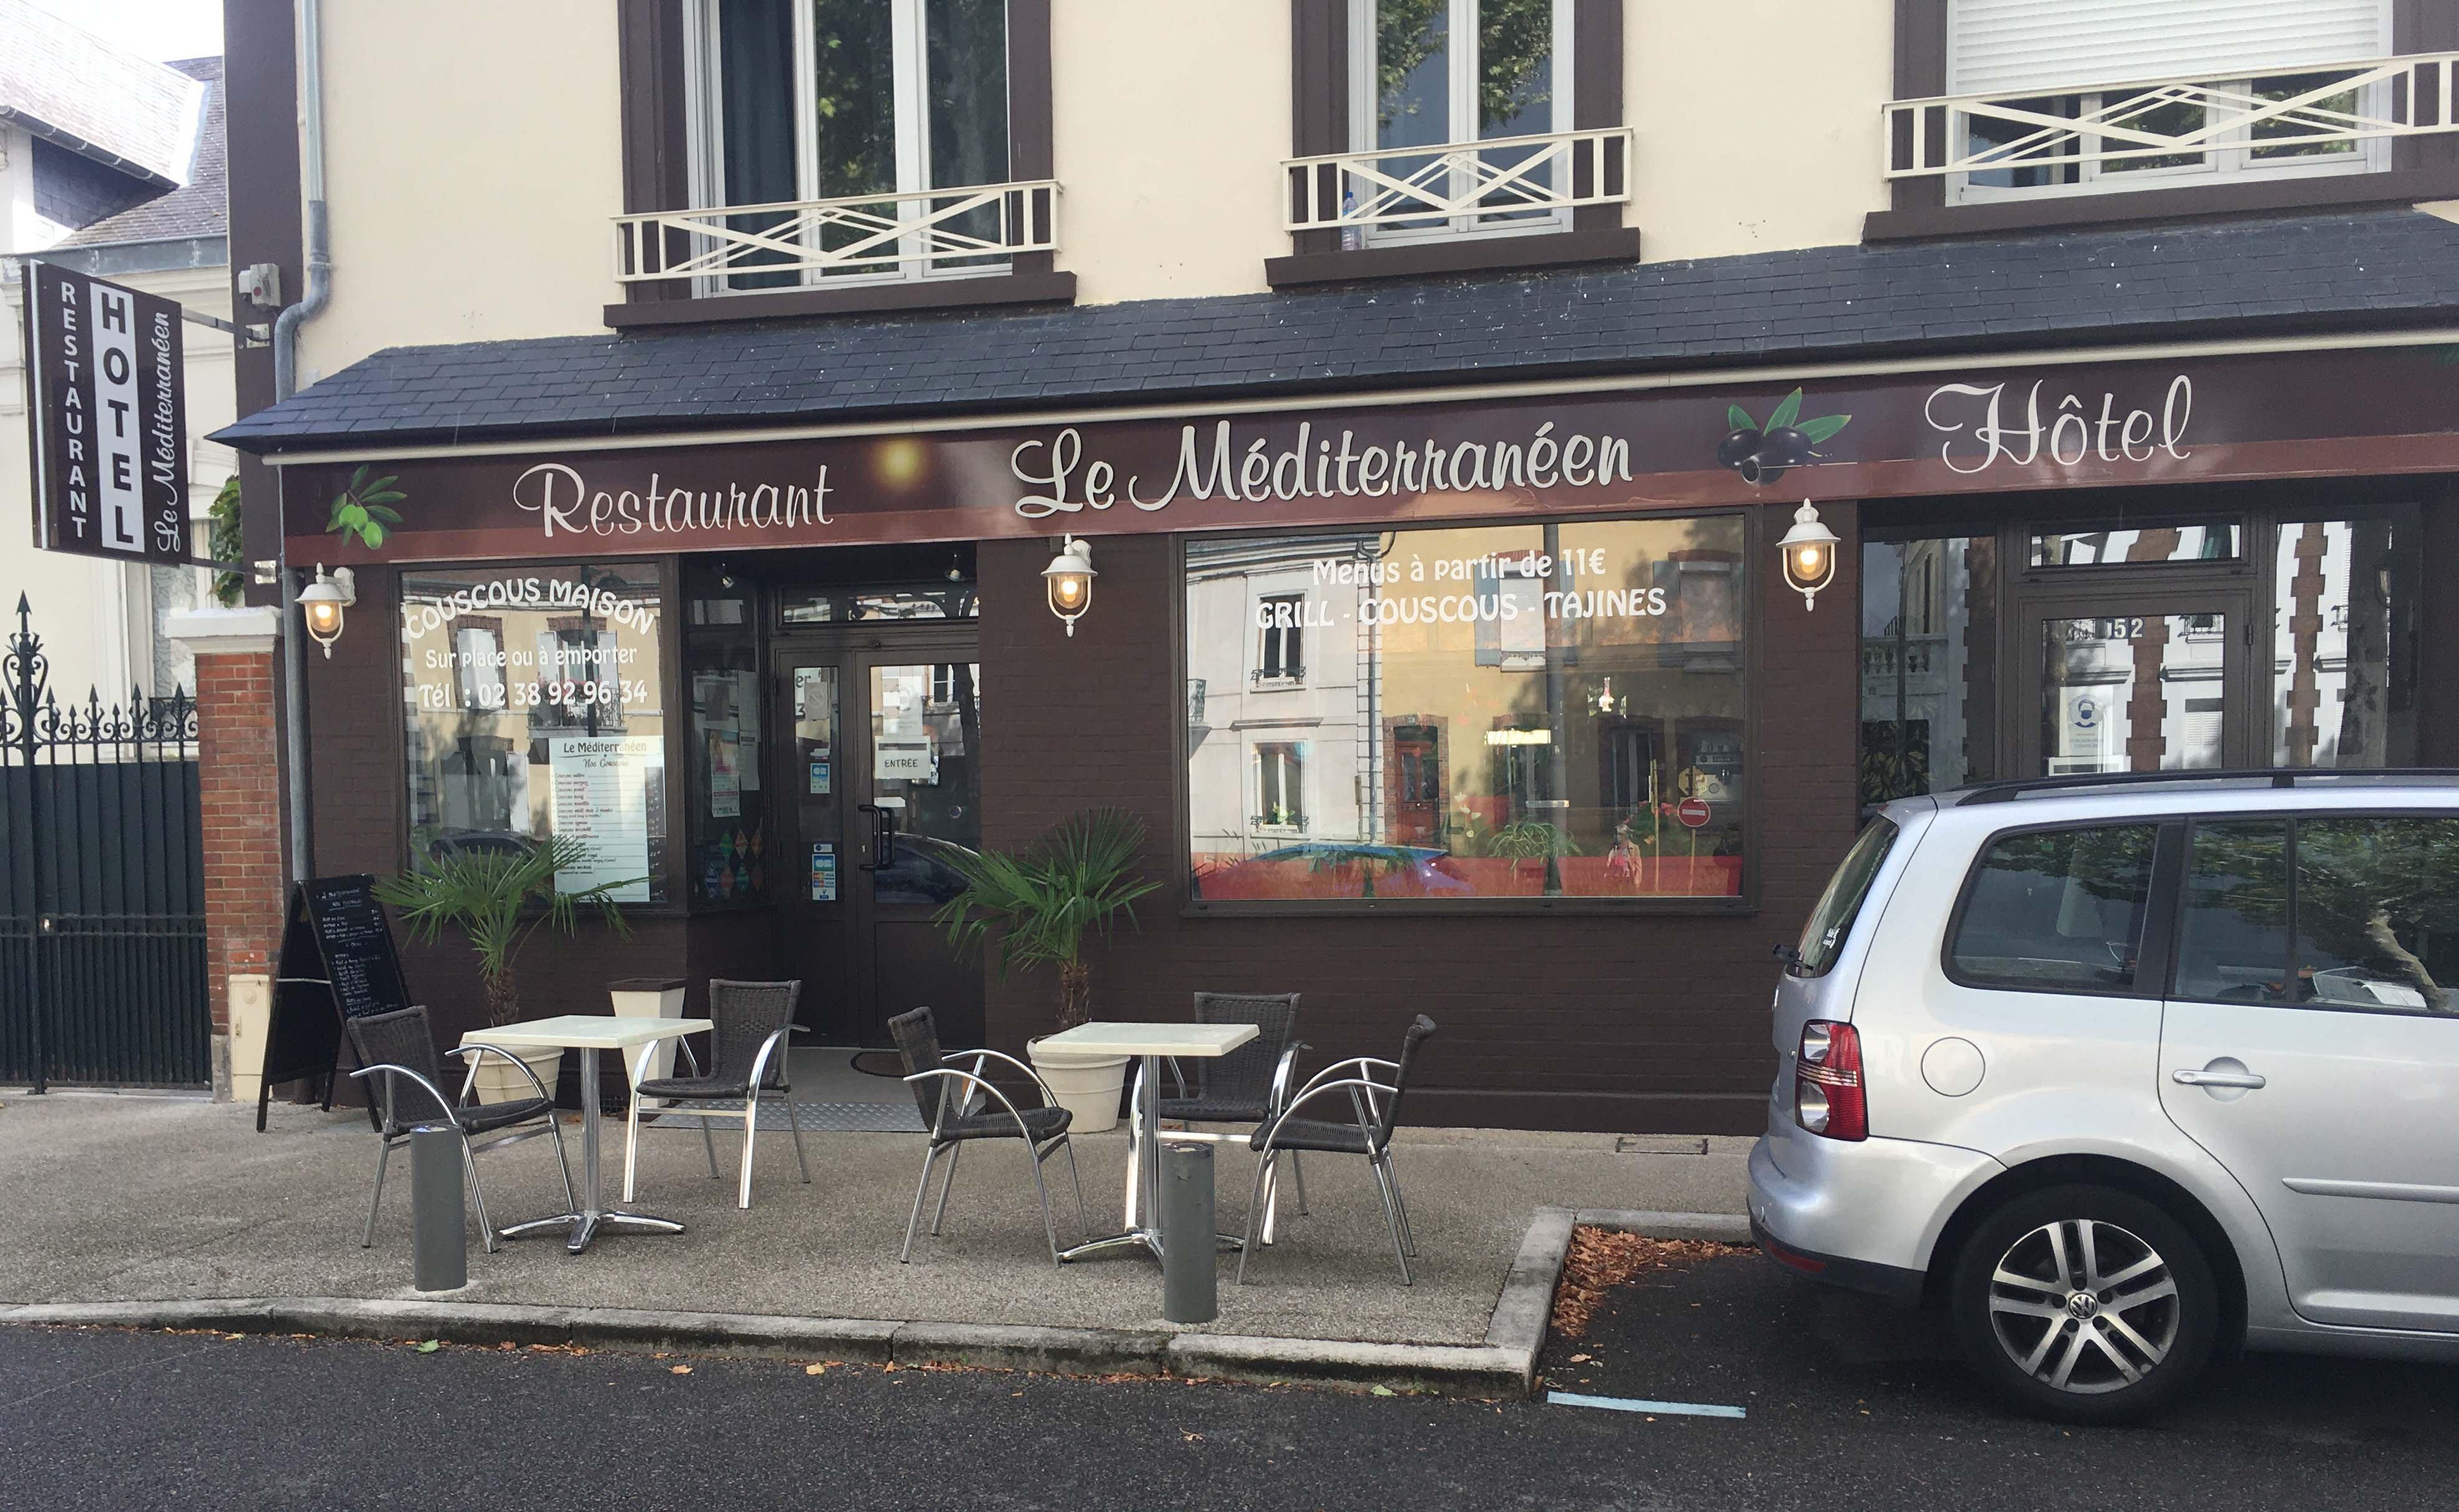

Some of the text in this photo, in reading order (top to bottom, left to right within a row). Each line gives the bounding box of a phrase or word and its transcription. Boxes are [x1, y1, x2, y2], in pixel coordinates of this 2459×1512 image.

[61, 281, 87, 538] RESTAURANT
[101, 291, 133, 544] HOTEL
[152, 312, 181, 553] Le Méditerranéen
[1924, 374, 2192, 474] Hôtel
[1011, 420, 1634, 518] Le Méditerranéen
[513, 463, 835, 537] Restaurant
[1312, 548, 1606, 586] Menus à partir de 11€
[406, 578, 655, 639] COUSCOUS MAISON
[1255, 600, 1335, 629] GRILL
[1359, 594, 1519, 626] COUSCOUS
[1543, 588, 1667, 619] TAJINES
[425, 645, 638, 669] Sur place ou à emporter
[419, 682, 451, 708] Tél
[478, 683, 507, 707] 02
[514, 681, 541, 706] 38
[548, 680, 576, 705] 92
[583, 680, 612, 705] 96
[619, 678, 649, 704] 34
[563, 740, 647, 754] Le Méditerranéen
[884, 757, 919, 768] ENTRÉE
